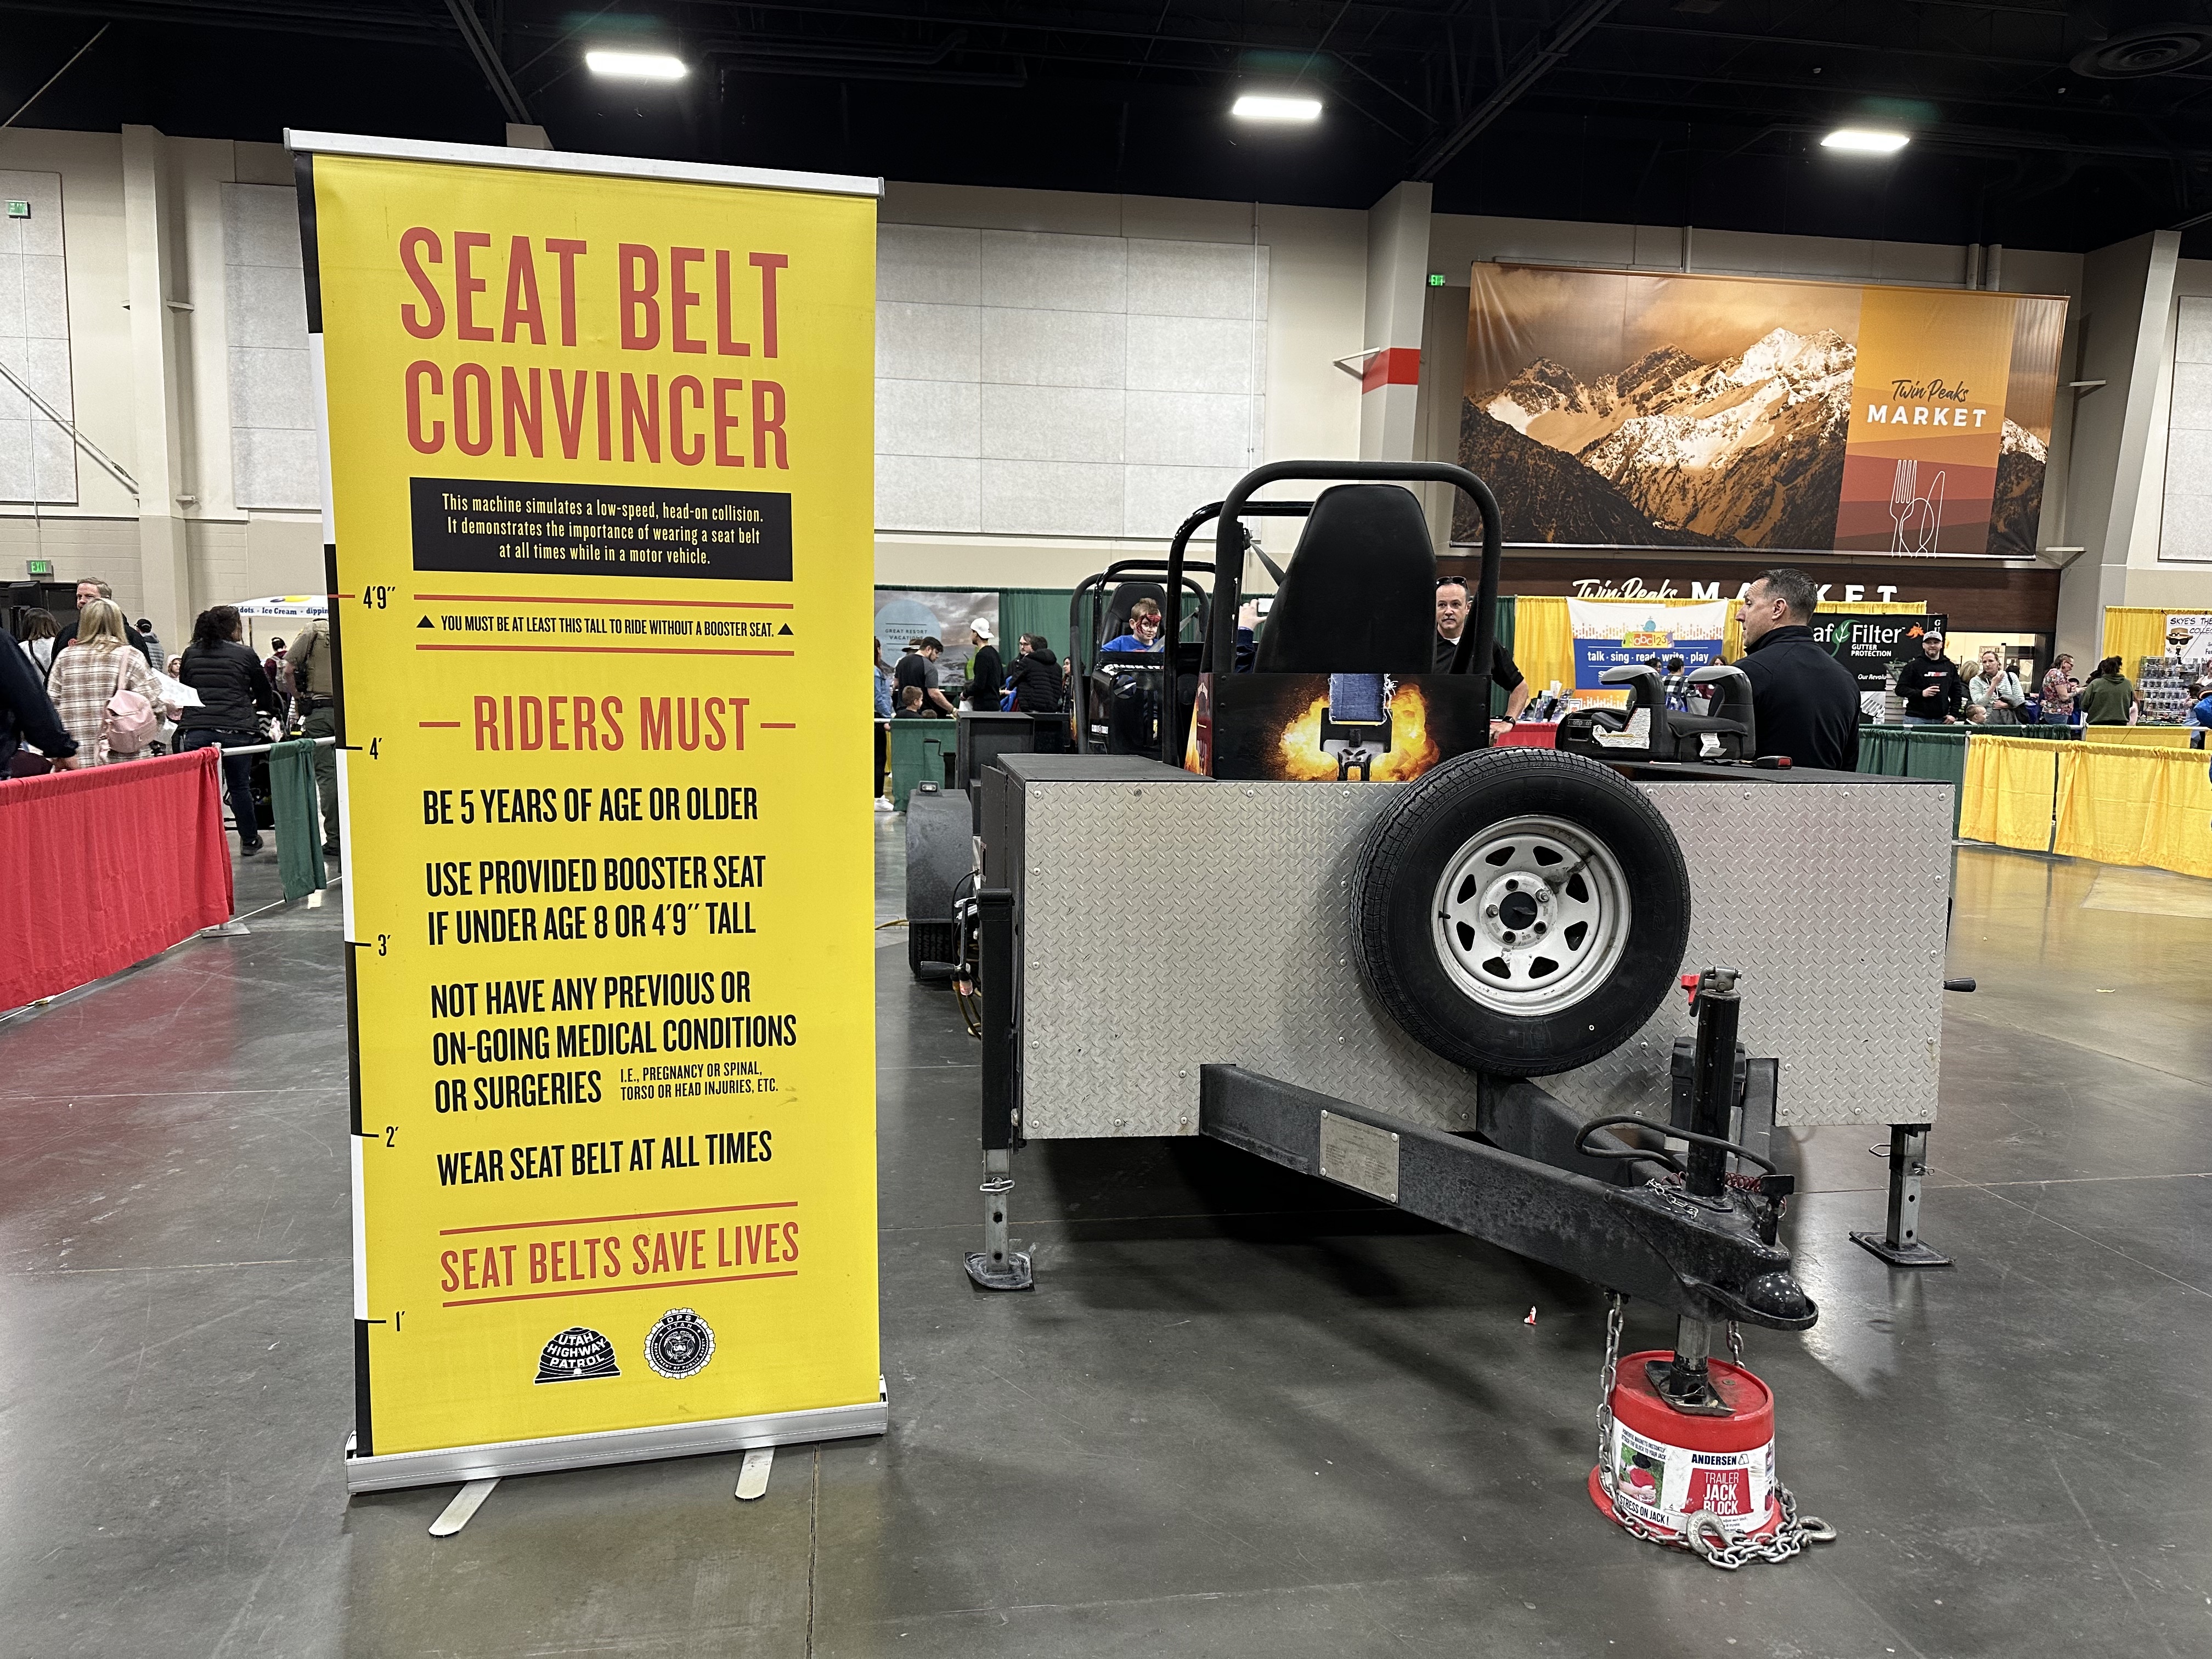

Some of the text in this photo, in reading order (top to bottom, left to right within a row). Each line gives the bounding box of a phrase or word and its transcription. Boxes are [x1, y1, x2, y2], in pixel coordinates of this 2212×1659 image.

[400, 227, 788, 358] SEAT BELT
[1892, 379, 1969, 403] Twin Peaks
[405, 360, 789, 470] CONVINCER
[1867, 404, 1987, 427] MARKET
[442, 493, 763, 522] This machine simulates a low-speed, head-on collision.
[448, 517, 759, 545] It demonstrates the importance of wearing a seat belt
[500, 542, 709, 564] at all times while in a motor vehicle.
[31, 562, 46, 572] EXIT
[441, 616, 774, 637] YOU MUST BE AT LEAST THIS TALL TO RIDE WITHOUT A BOOSTER SEAT.
[1852, 624, 1900, 643] Filter
[1588, 651, 1709, 663] talk sing read write play
[474, 696, 749, 751] RIDERS MUST
[370, 737, 382, 759] 4'
[424, 787, 758, 825] BE 5 YEARS OF AGE OR OLDER
[426, 856, 766, 896] USE PROVIDED BOOSTER SEAT
[428, 911, 448, 945] IF
[456, 908, 537, 944] UNDER
[544, 906, 587, 940] AGE
[595, 906, 607, 939] 8
[616, 905, 646, 938] OR
[706, 902, 756, 934] TALL
[378, 934, 391, 956] 3'
[431, 972, 751, 1018] NOT HAVE ANY PREVIOUS OR
[433, 1014, 796, 1066] ON-GOING MEDICAL CONDITIONS
[621, 1061, 761, 1083] I.E., PREGNANCY OR SPINAL,
[435, 1070, 601, 1113] OR SURGERIES
[620, 1078, 778, 1101] TORSO OR HEAD INJURIES, ETC.
[386, 1126, 398, 1147] 2'
[437, 1131, 771, 1186] WEAR SEAT BELT AT ALL TIMES
[441, 1222, 798, 1292] SEAT BELTS SAVE LIVES
[667, 1315, 691, 1323] DPS
[546, 1339, 606, 1357] HIGHWAY
[558, 1333, 594, 1346] UTAH
[549, 1355, 605, 1369] PATROL
[682, 1357, 699, 1369] PUBLIC
[1691, 1454, 1737, 1465] ANDERSEN
[1704, 1472, 1739, 1484] TRAILER
[1704, 1483, 1737, 1500] JACK
[1620, 1495, 1639, 1514] STRESS
[1640, 1506, 1648, 1518] ON
[1703, 1500, 1739, 1515] BLOCK
